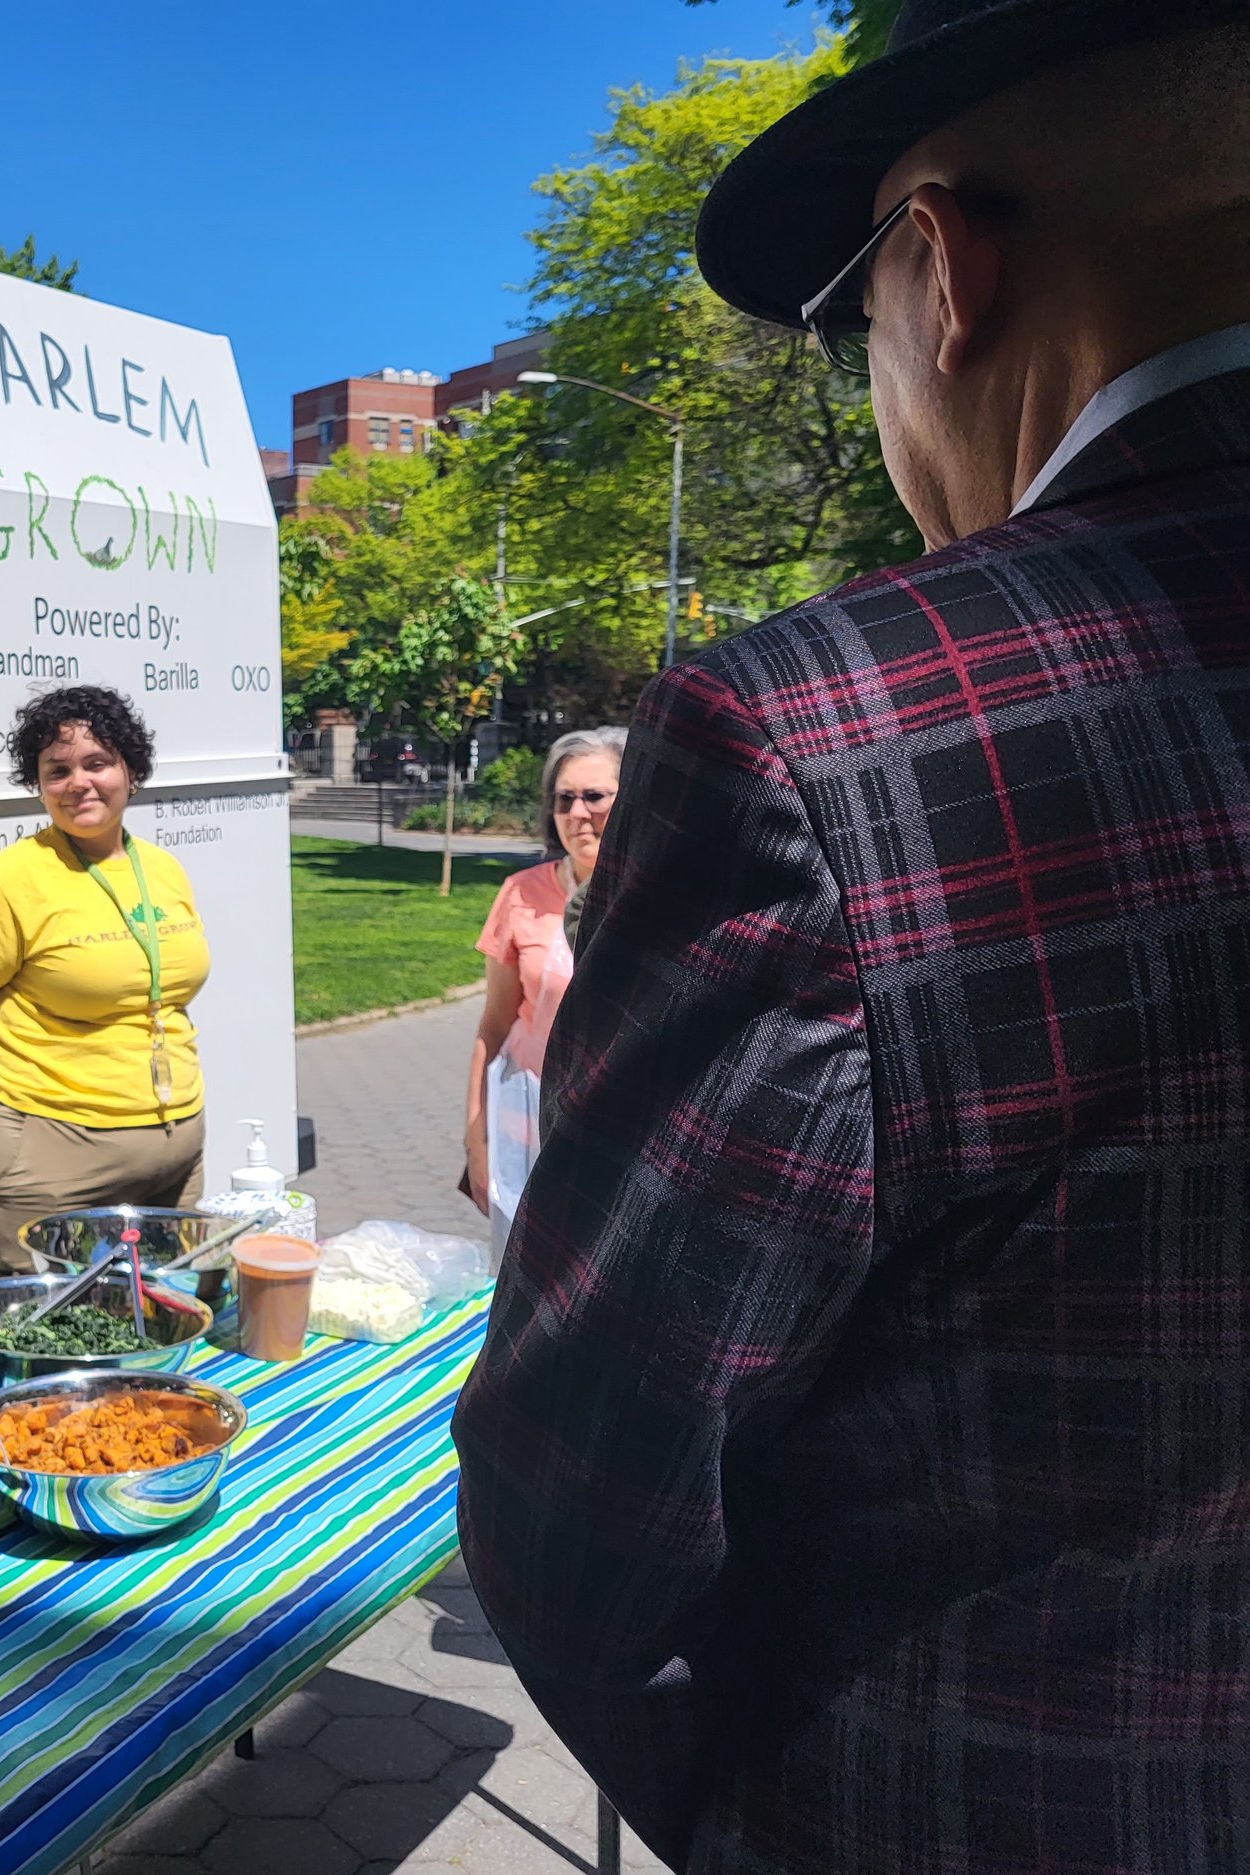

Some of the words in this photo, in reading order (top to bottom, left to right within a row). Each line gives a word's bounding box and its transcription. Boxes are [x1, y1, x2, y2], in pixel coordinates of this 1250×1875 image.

[34, 597, 141, 640] Powered
[148, 605, 180, 650] By:
[144, 662, 199, 692] Barilla
[231, 664, 271, 692] OXO
[155, 798, 168, 818] B.
[172, 797, 212, 818] Robert
[216, 793, 274, 813] Williamson
[156, 824, 223, 847] Foundation
